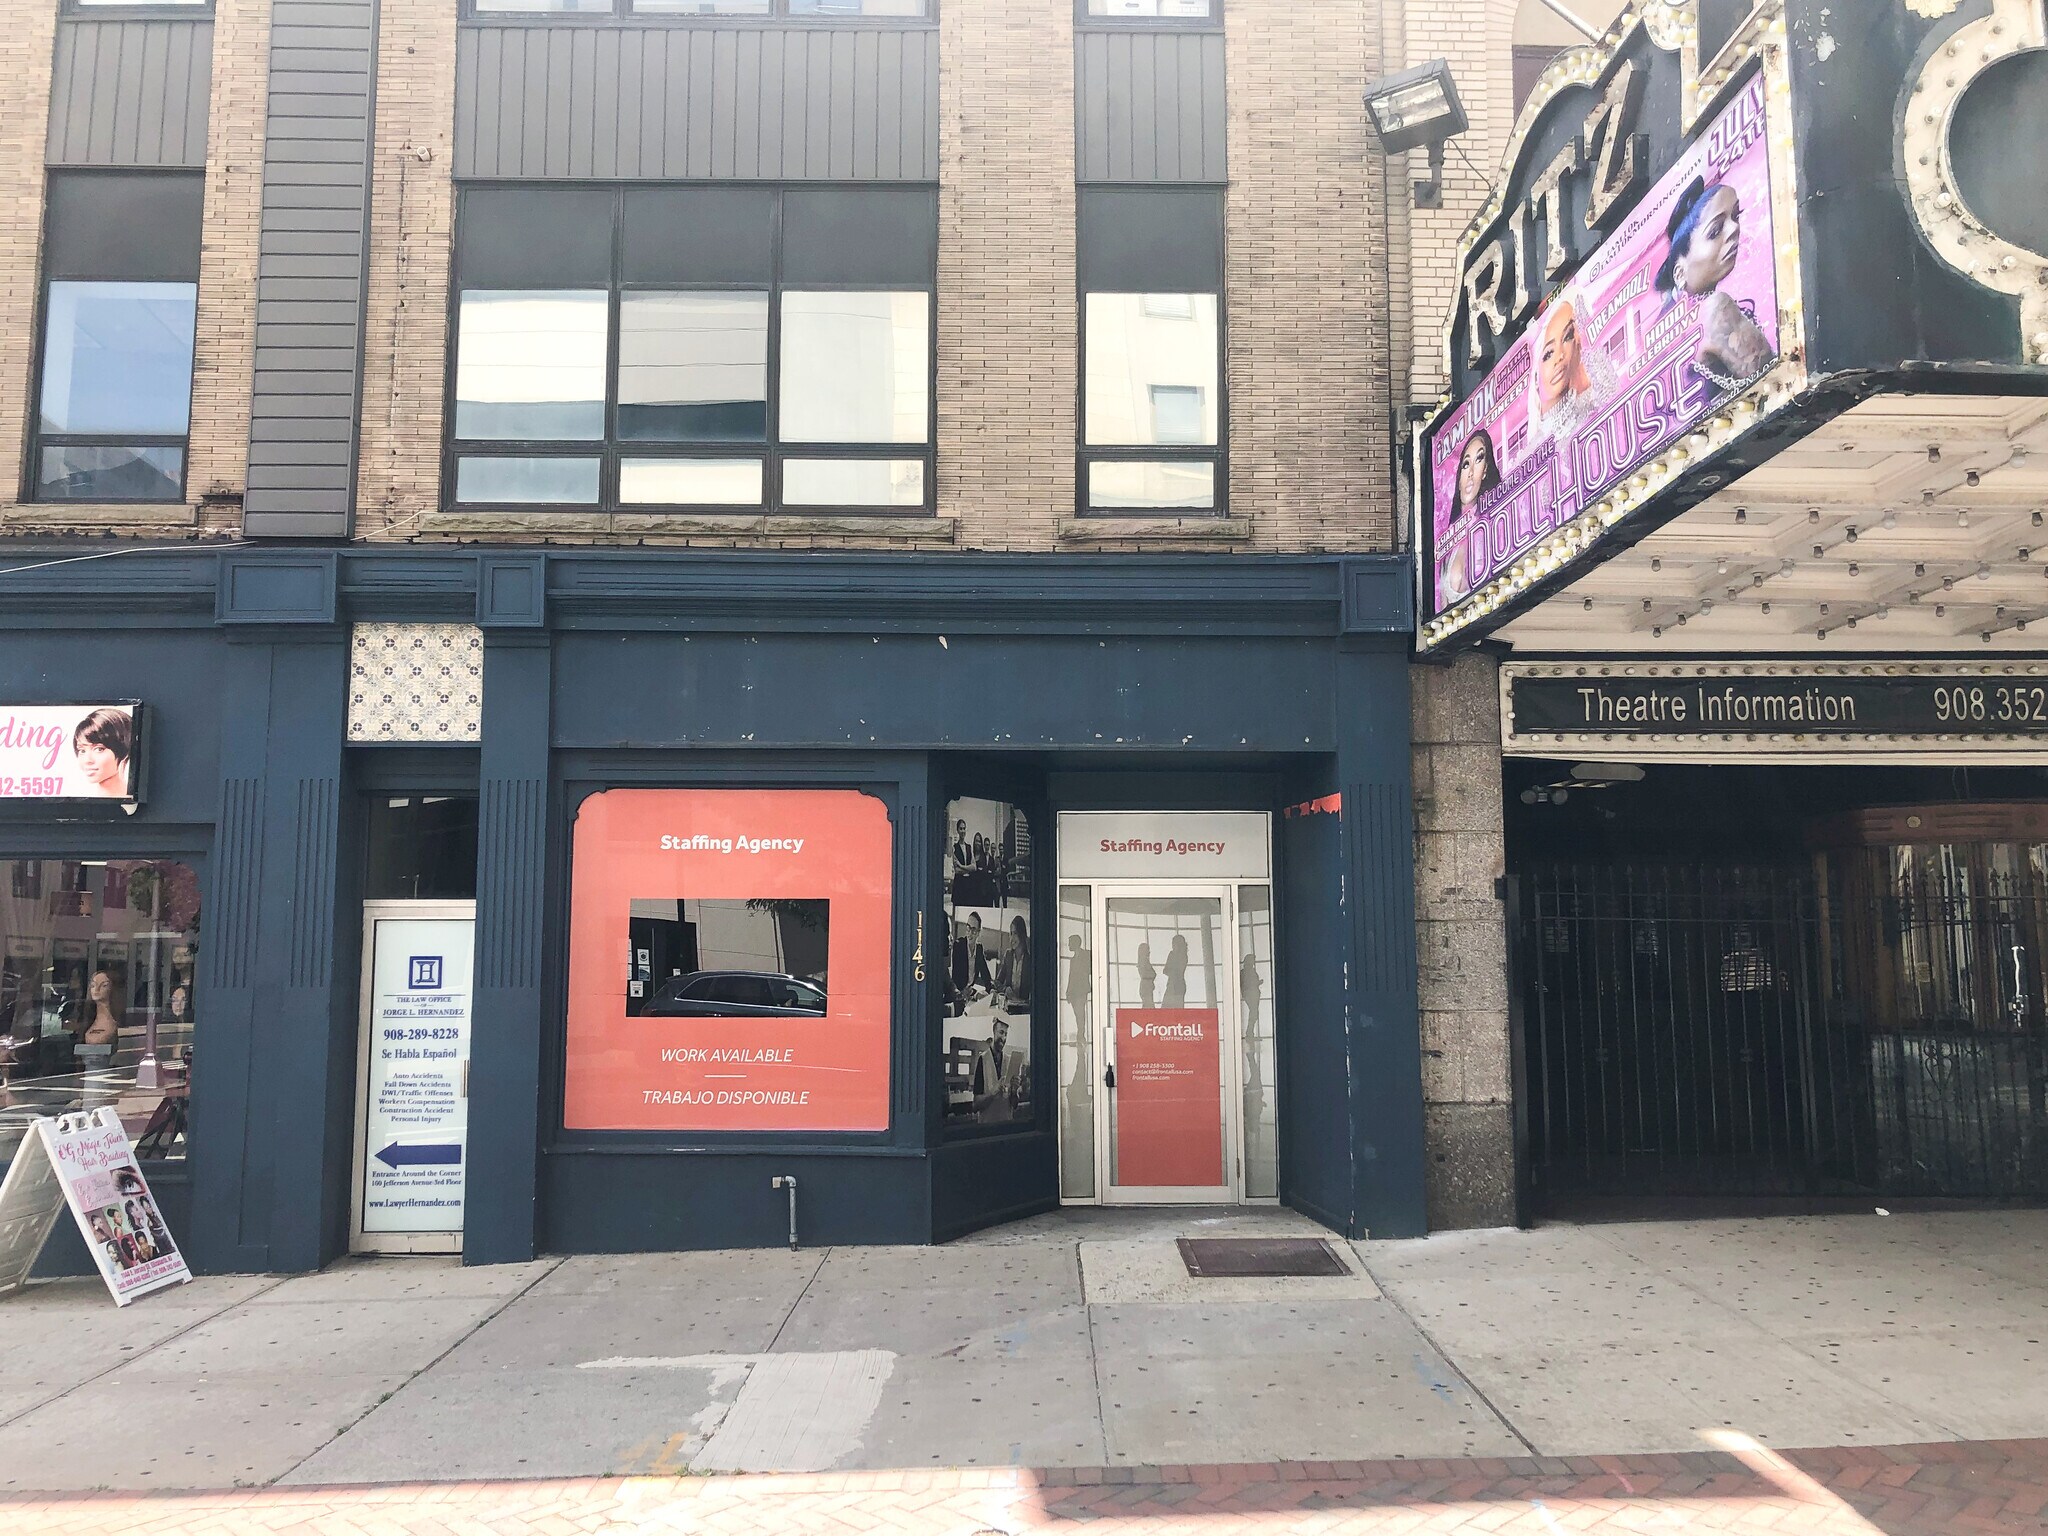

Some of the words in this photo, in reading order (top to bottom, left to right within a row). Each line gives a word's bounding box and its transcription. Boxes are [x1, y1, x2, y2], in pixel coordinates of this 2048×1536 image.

[1708, 78, 1764, 166] JULY
[1717, 114, 1765, 180] 24TH
[1463, 58, 1636, 370] RITZ
[1587, 263, 1650, 344] DREAMDOLL
[1645, 301, 1685, 349] HOOD
[1629, 305, 1700, 377] CELEBRITYY
[1496, 353, 1530, 404] MORNING
[1486, 374, 1529, 426] CONCERT
[1479, 468, 1520, 513] WELCOME
[1521, 459, 1534, 481] TO
[1534, 434, 1557, 472] THE
[1577, 687, 1686, 722] Theatre
[1699, 687, 1856, 722] Information
[1934, 686, 2048, 721] 908.352
[0, 777, 63, 796] 2-5597
[660, 835, 732, 854] Staffing
[735, 835, 804, 854] Agency
[1100, 839, 1162, 855] Staffing
[1165, 839, 1225, 855] Agency
[912, 911, 926, 982] 1146
[383, 1008, 407, 1016] JORGE
[417, 1008, 464, 1016] HERNANDEZ
[383, 1028, 459, 1040] 908-289-8228
[382, 1049, 392, 1058] Se
[395, 1049, 420, 1058] Habla
[423, 1048, 457, 1061] Español
[661, 1049, 709, 1062] WORK
[710, 1049, 794, 1063] AVAILABLE
[407, 1098, 455, 1106] Compensation
[642, 1090, 714, 1105] TRABAJO
[716, 1091, 810, 1105] DISPONIBLE
[383, 1179, 409, 1187] Jefferson
[369, 1199, 461, 1209] www.LawyerHernandez.com
